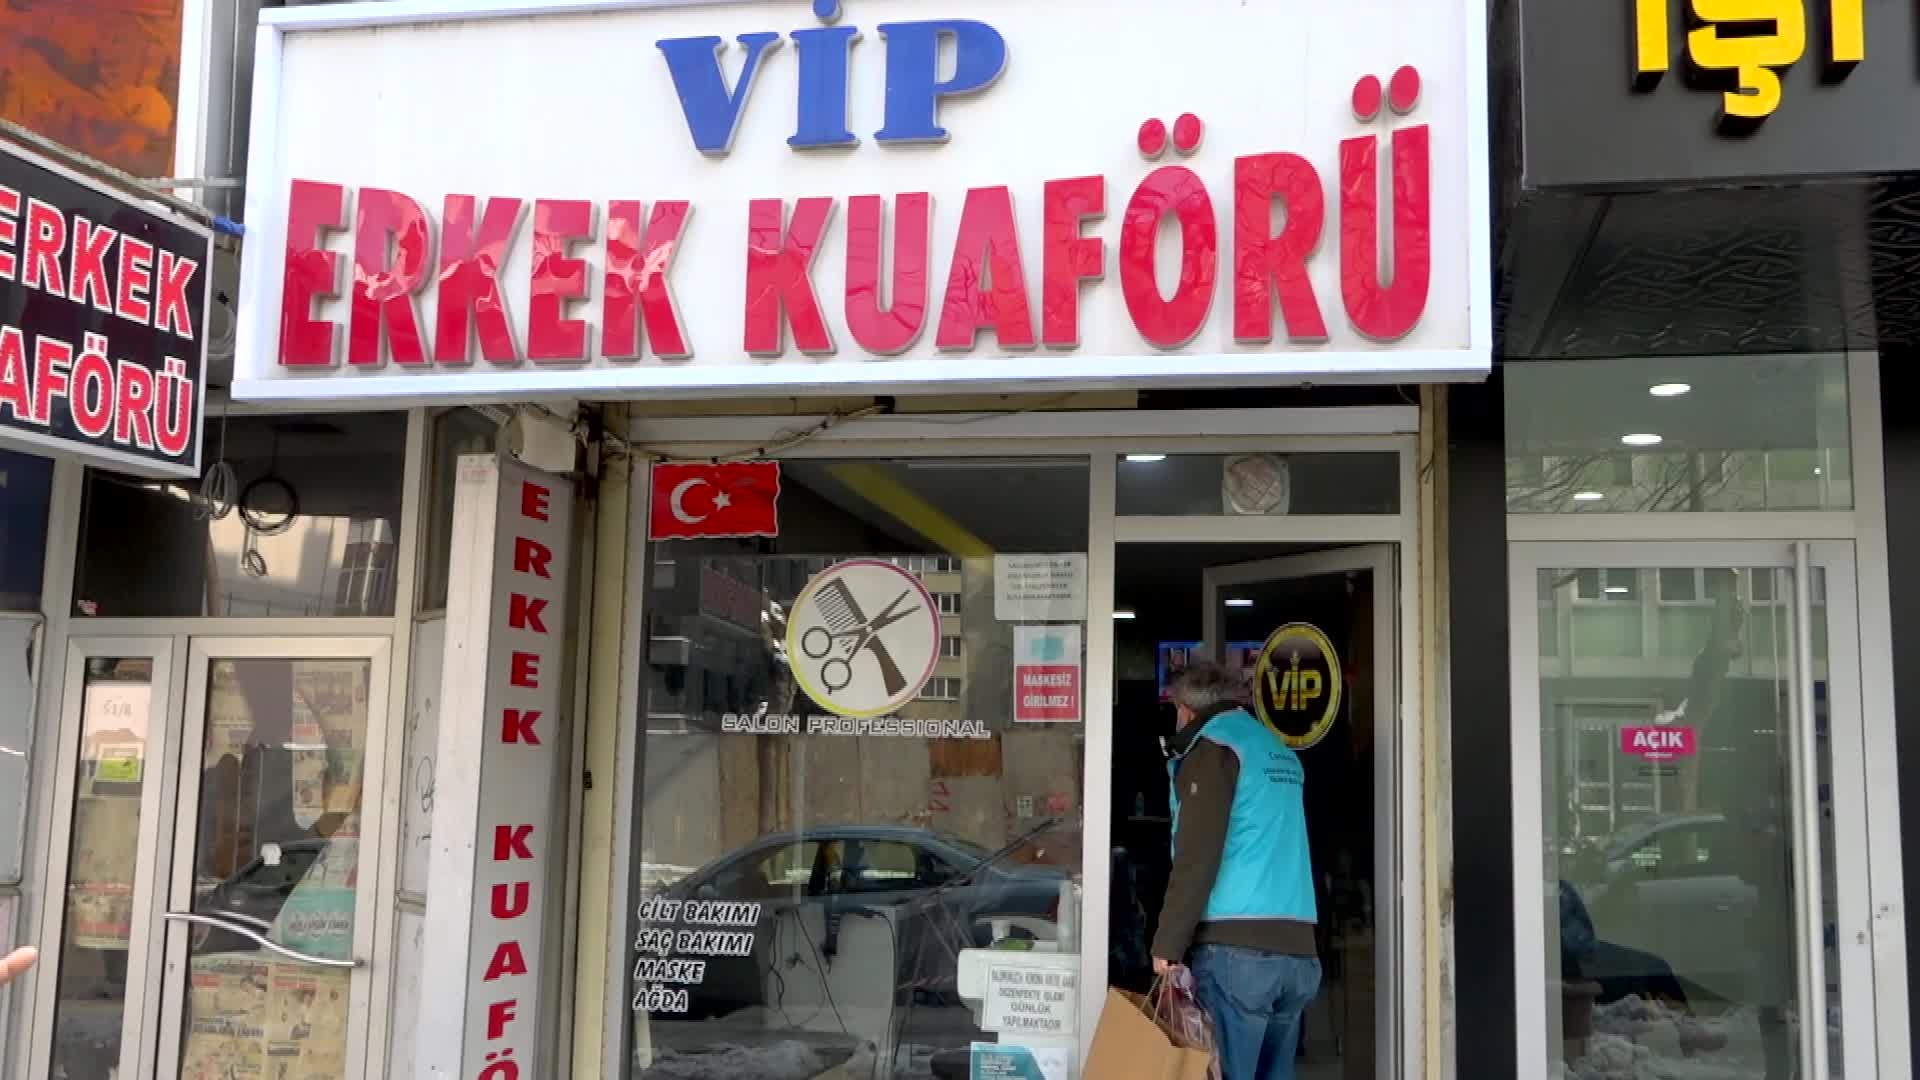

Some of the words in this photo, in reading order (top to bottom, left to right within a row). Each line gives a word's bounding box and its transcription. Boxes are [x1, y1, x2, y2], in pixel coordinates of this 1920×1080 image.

[656, 0, 1010, 156] VİP
[279, 177, 694, 369] ERKEK
[743, 64, 1430, 358] KUAFÖRÜ
[501, 480, 552, 746] ERKEK
[721, 712, 800, 734] SALON
[807, 715, 991, 739] PROFESSIONAL
[1633, 731, 1684, 750] AÇIK
[637, 895, 682, 922] CİLT
[683, 900, 761, 926] BAKIMI
[635, 928, 674, 956] SAÇ
[676, 930, 754, 956] BAKIMI
[633, 958, 706, 984] MASKE
[632, 983, 689, 1012] AĞDA
